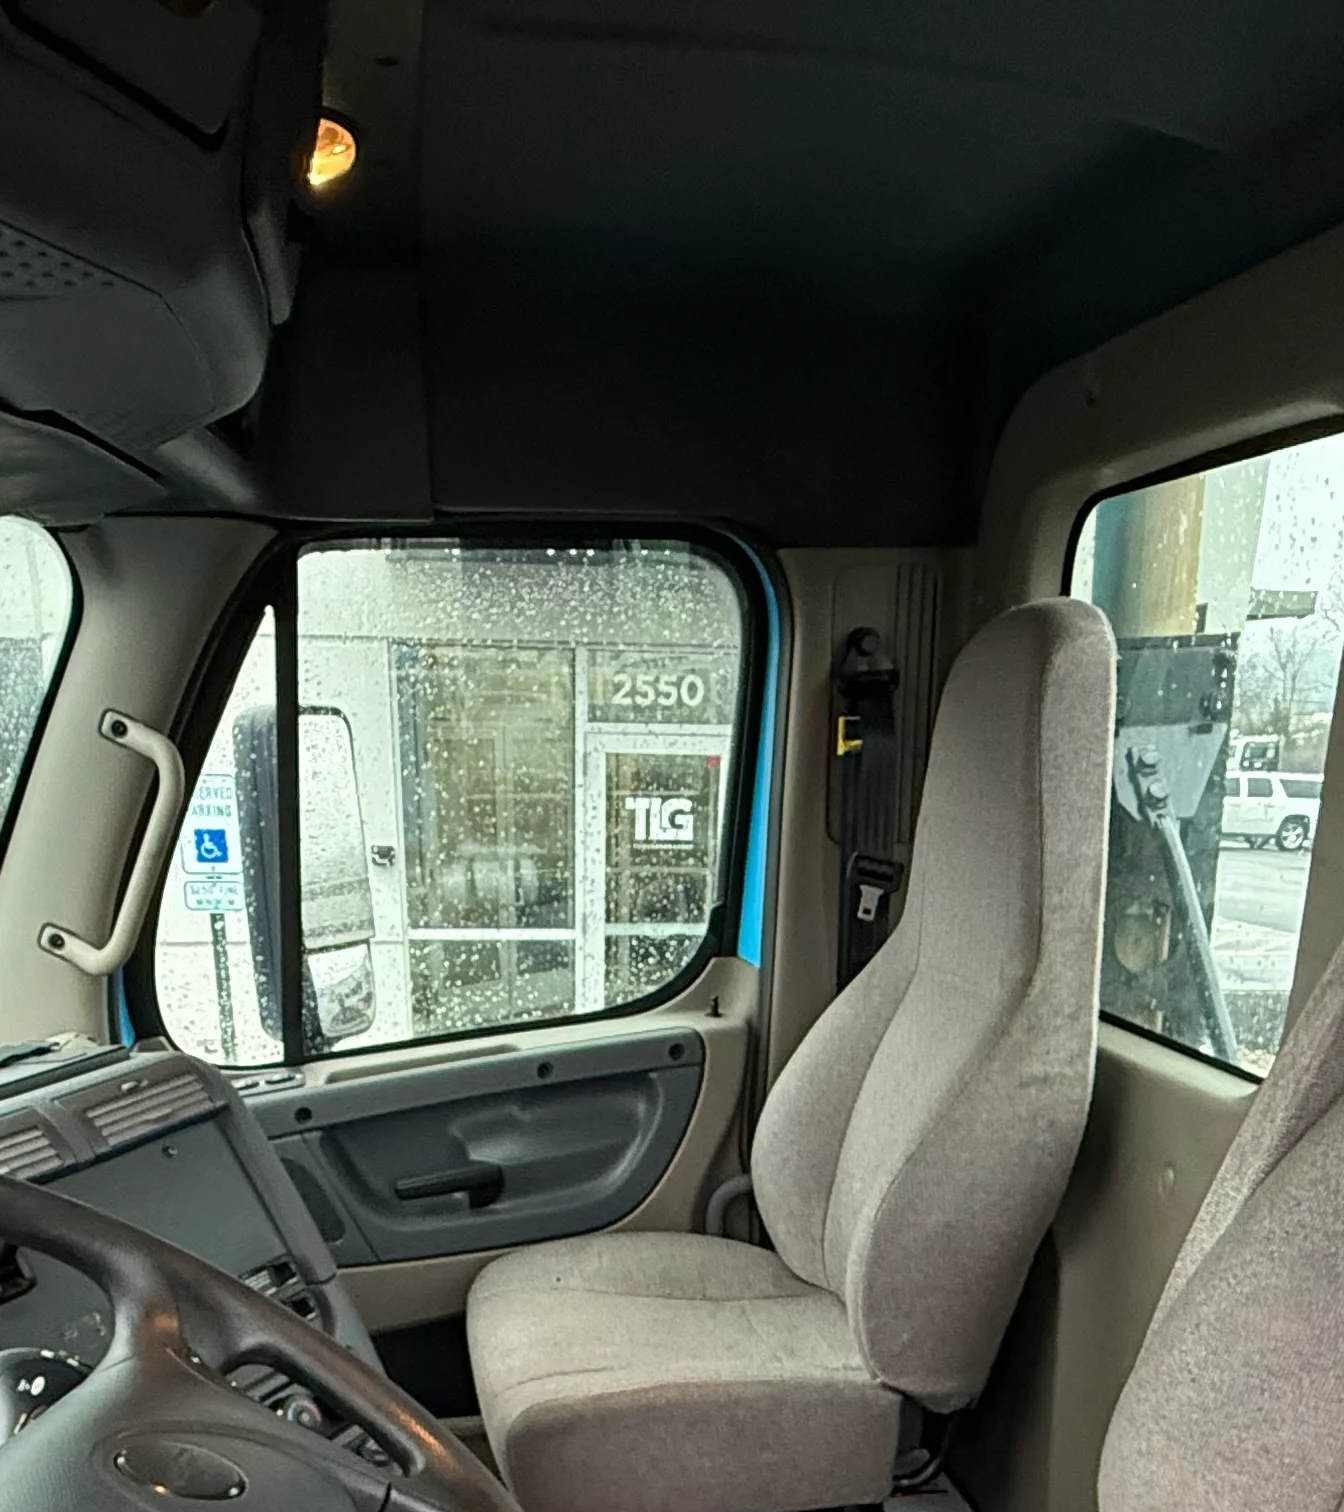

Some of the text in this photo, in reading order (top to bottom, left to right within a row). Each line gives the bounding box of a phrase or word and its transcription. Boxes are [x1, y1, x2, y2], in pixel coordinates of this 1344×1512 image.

[611, 673, 705, 707] 2550
[191, 804, 232, 817] ARKING
[625, 797, 694, 840] TLG
